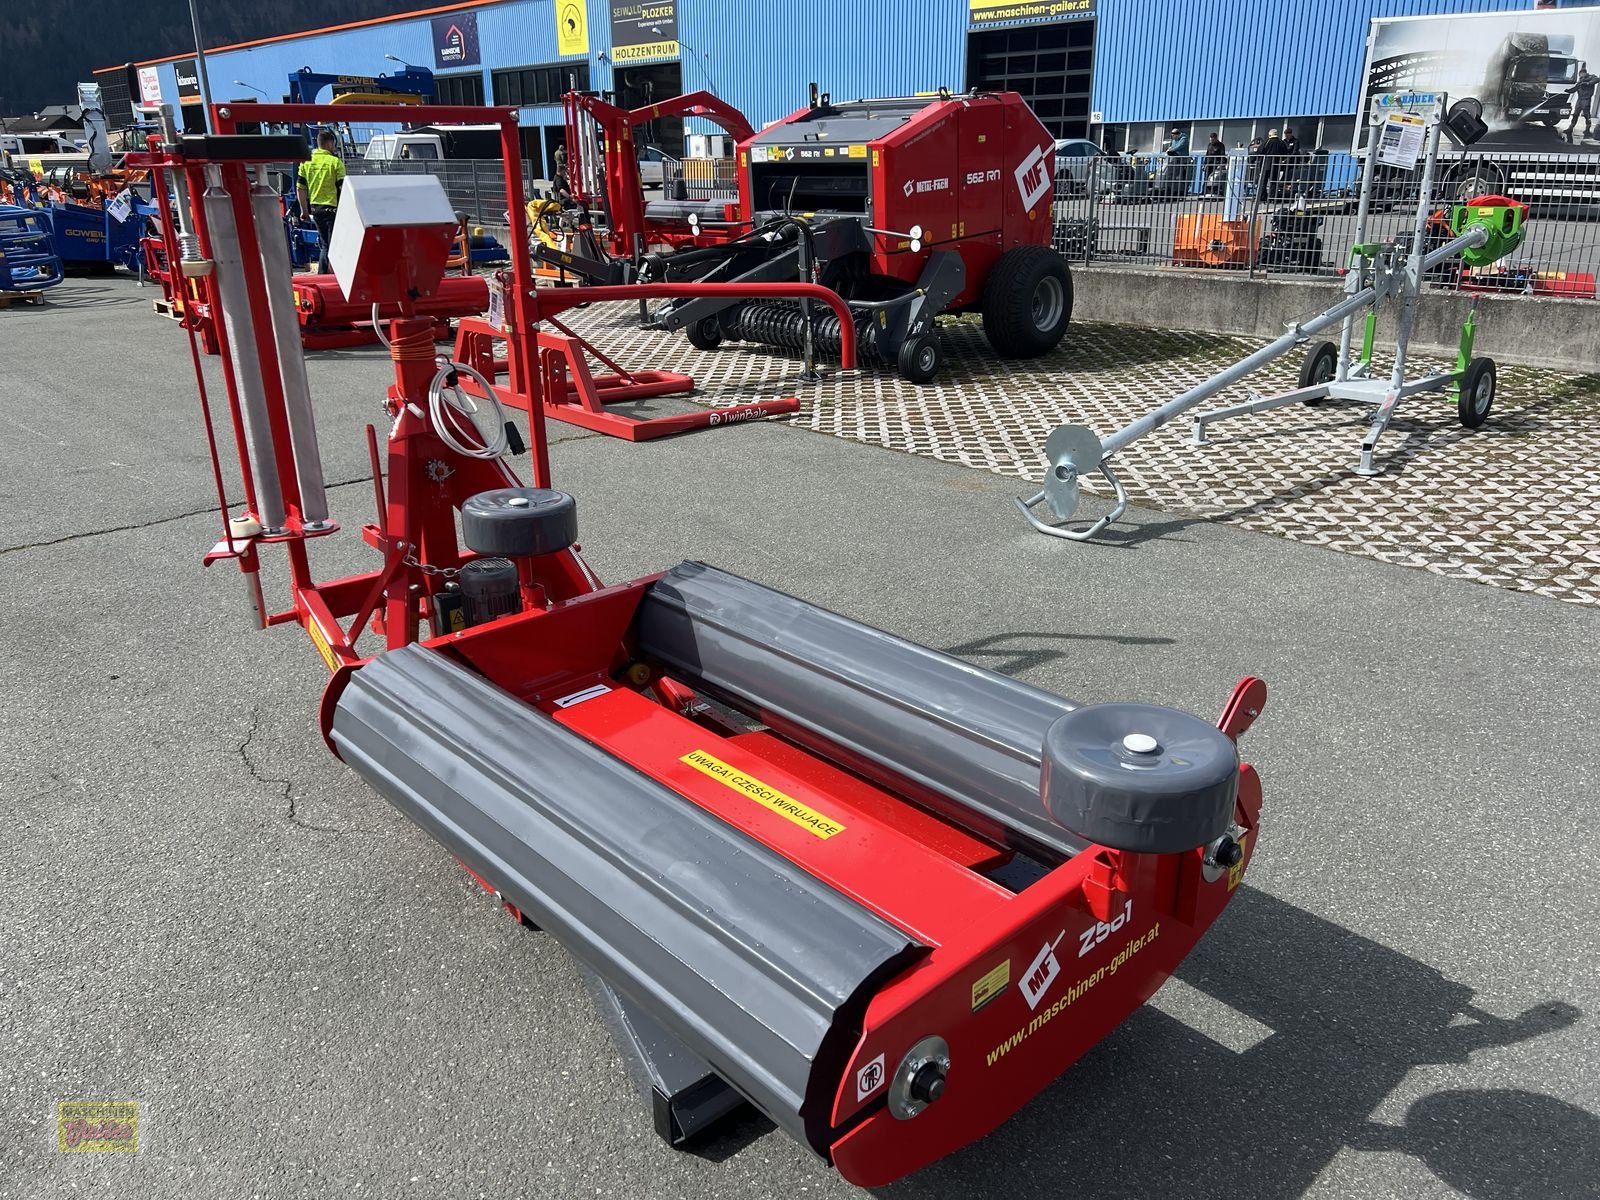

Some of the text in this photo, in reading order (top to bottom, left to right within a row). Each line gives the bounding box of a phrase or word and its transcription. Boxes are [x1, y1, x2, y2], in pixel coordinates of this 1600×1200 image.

[613, 5, 674, 19] SEIWALD PLOZKER
[974, 0, 1090, 21] www.maschinen-gailer.at
[615, 43, 676, 59] HOLZZENTRUM
[1402, 95, 1434, 104] BAUER
[966, 172, 984, 184] 562
[722, 408, 768, 424] TwinBale
[688, 753, 734, 779] UWAGA!
[773, 798, 838, 836] WIRUJĄCE
[986, 922, 1160, 1067] www.maschinen-gailer.at
